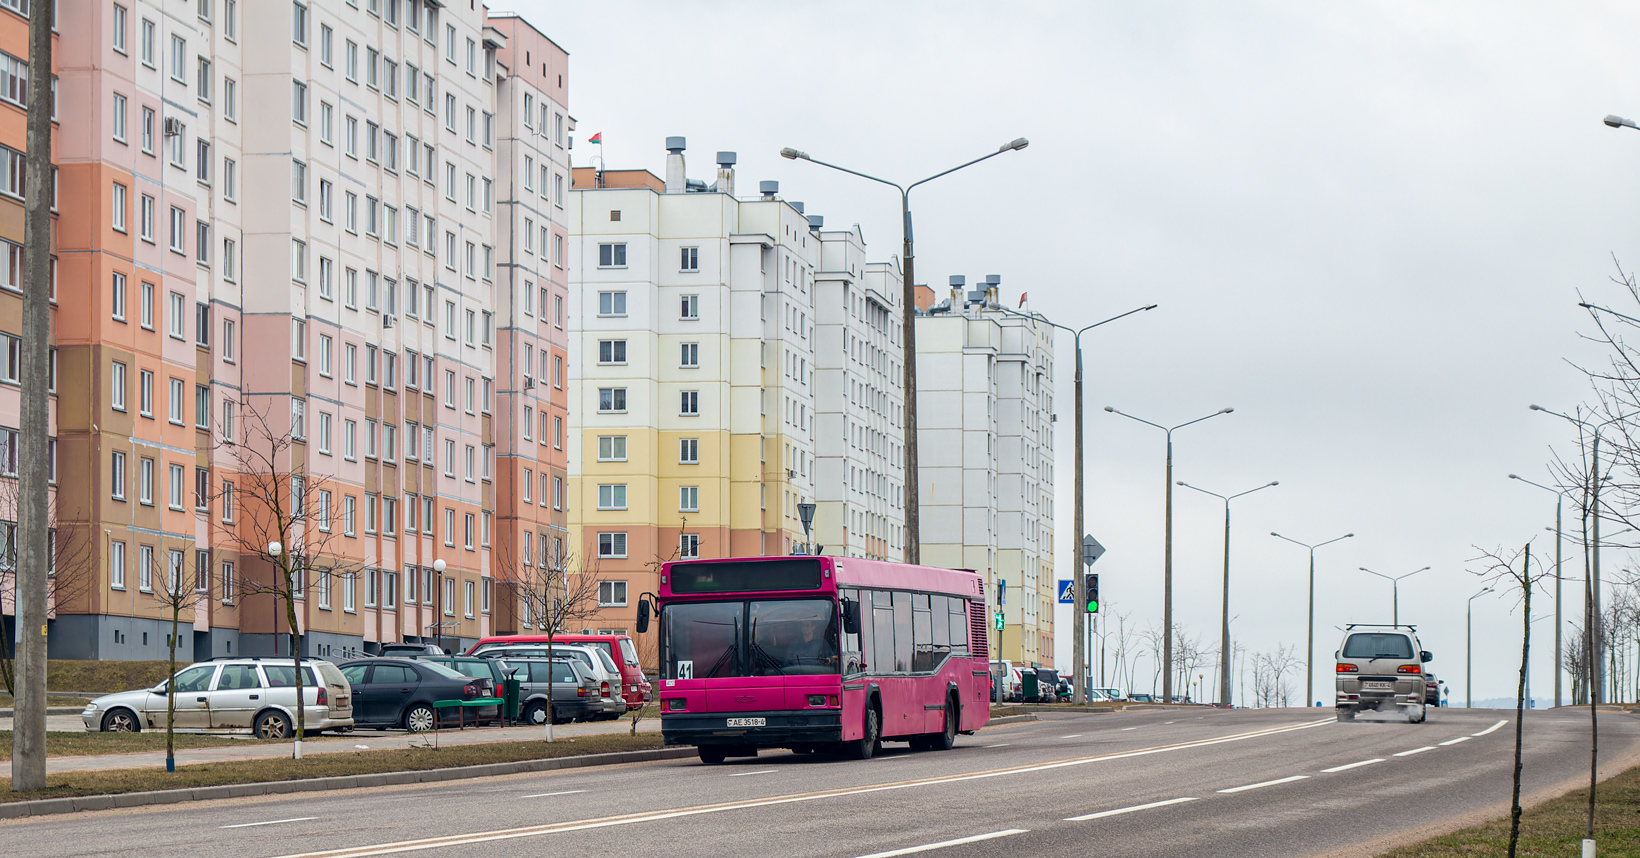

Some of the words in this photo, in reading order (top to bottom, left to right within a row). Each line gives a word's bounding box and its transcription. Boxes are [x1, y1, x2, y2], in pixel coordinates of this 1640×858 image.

[678, 664, 692, 679] 41
[733, 718, 743, 726] AE
[744, 717, 765, 726] 3518-4
